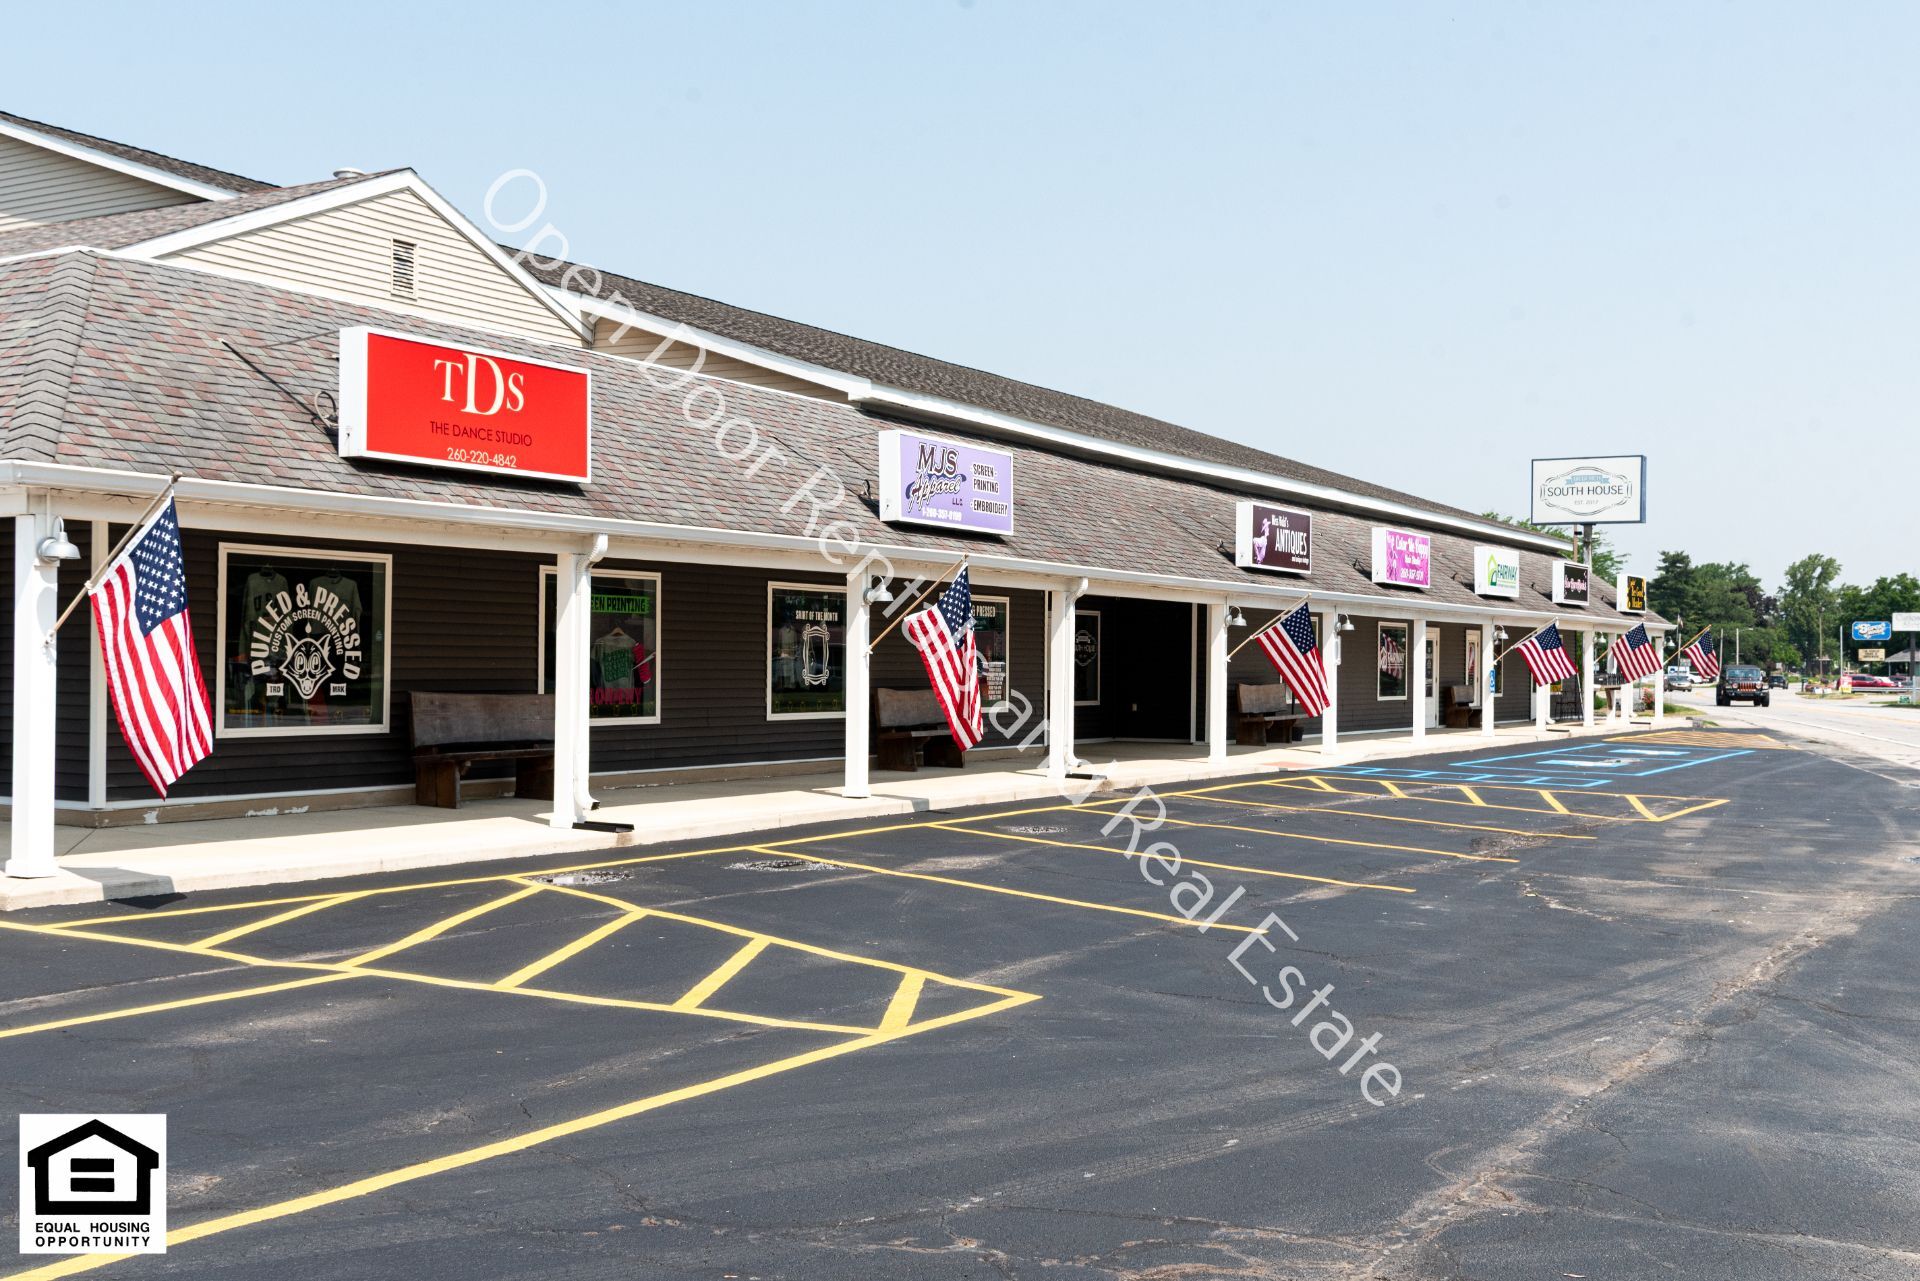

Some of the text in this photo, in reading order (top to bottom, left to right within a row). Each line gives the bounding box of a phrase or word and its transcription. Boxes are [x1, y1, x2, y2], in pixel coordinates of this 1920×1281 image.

[433, 353, 525, 416] TDS
[430, 421, 532, 447] THE DANCE STUDIO
[447, 447, 517, 468] 260-220-4842
[917, 441, 959, 477] MJS
[908, 472, 962, 513] Apparel
[973, 478, 999, 493] PRINTING
[1547, 484, 1624, 497] SOUTH HOUSE
[973, 499, 1008, 515] EMBROIDERY
[1275, 527, 1308, 556] ANTIQUES
[607, 596, 646, 612] PRINTING
[976, 605, 996, 618] PRESSED
[250, 583, 362, 680] PULLED & PRESSED
[271, 608, 344, 656] CUSTOM SCREEN PRINTING
[269, 685, 345, 694] TRD MRK
